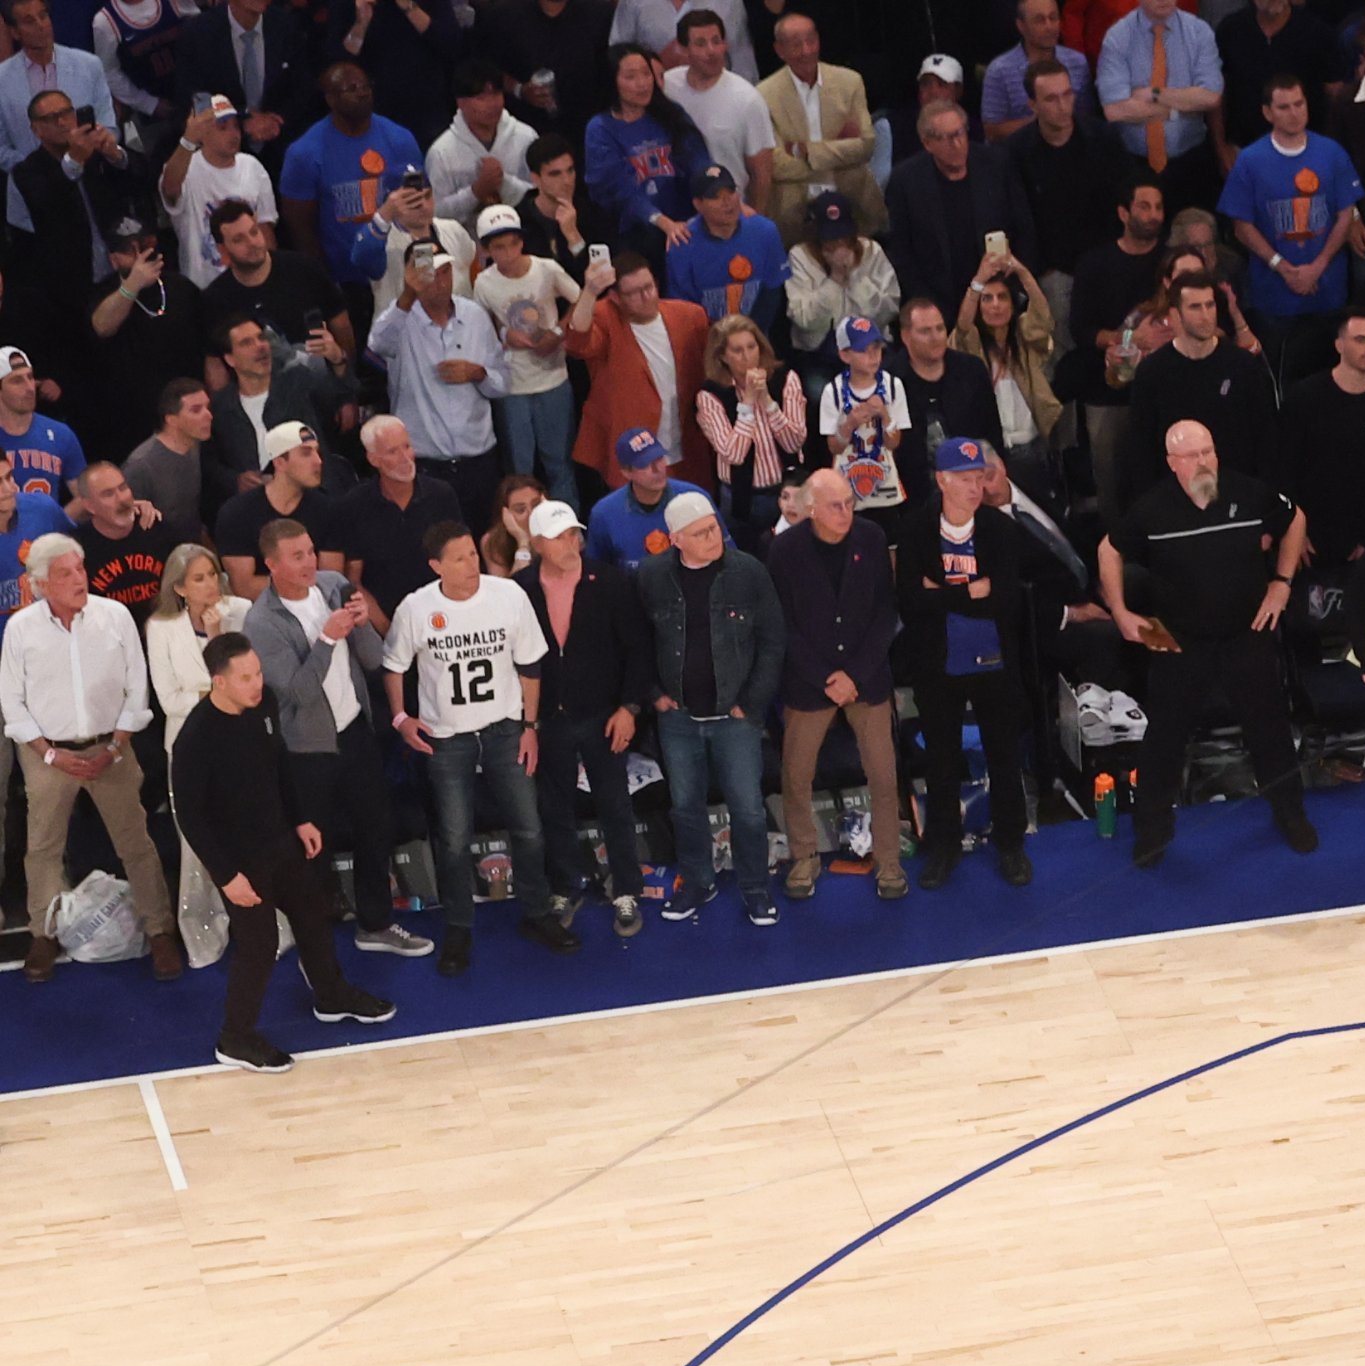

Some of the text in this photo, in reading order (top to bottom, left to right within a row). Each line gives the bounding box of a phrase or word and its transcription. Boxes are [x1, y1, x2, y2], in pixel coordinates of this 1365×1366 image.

[90, 553, 165, 591] NEW YORK
[433, 644, 505, 662] ALL AMERICAN
[448, 658, 495, 705] 12
